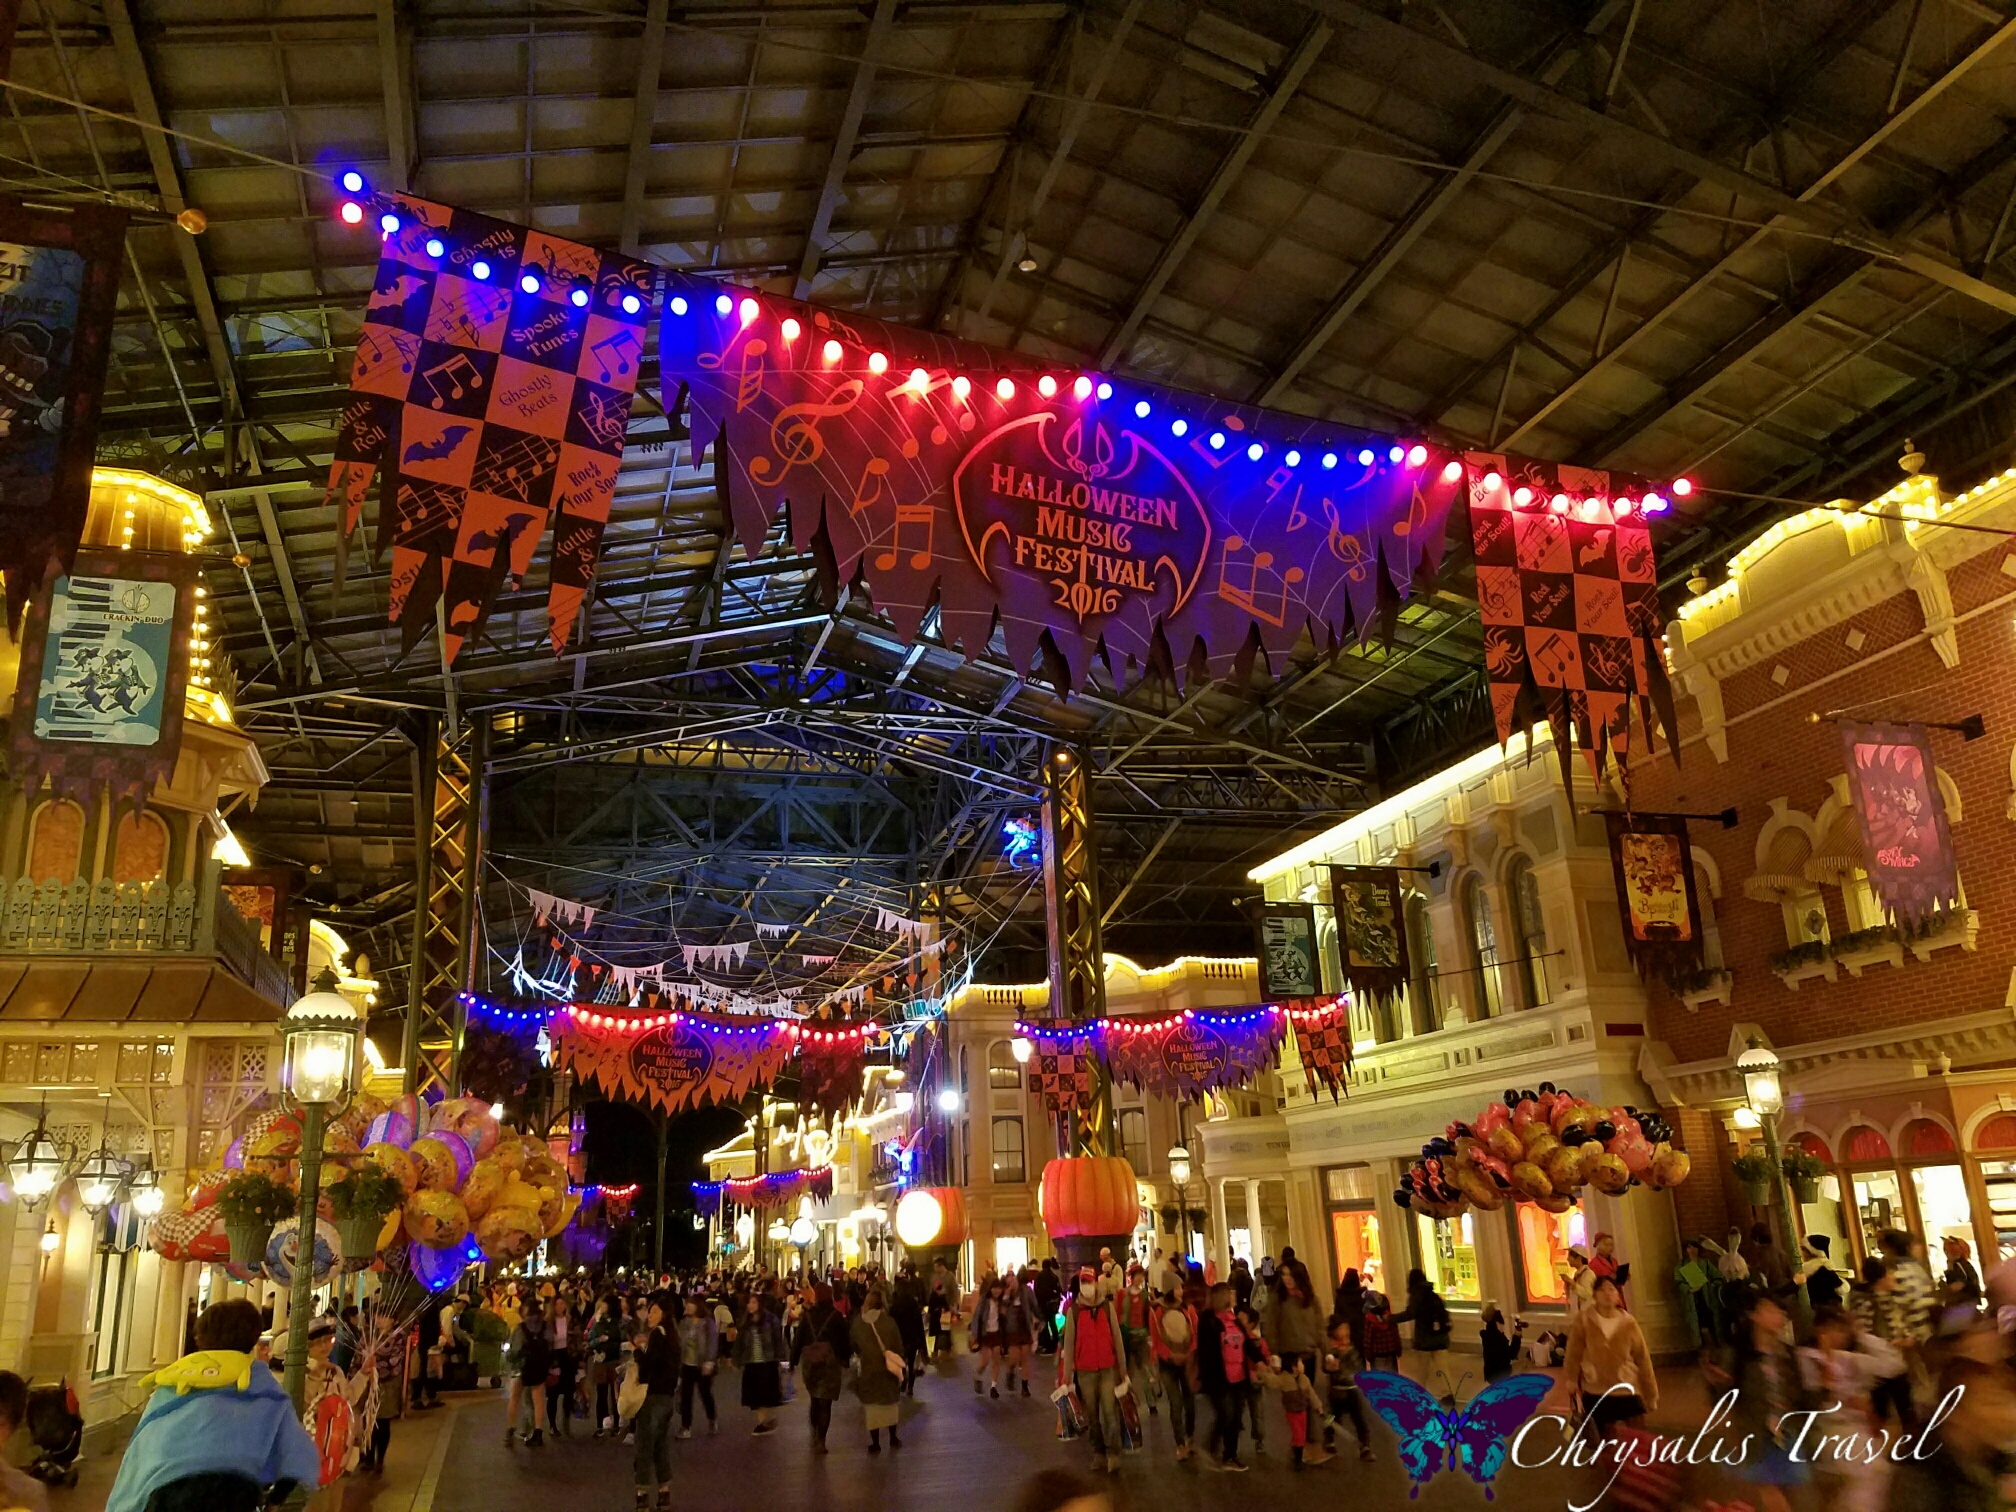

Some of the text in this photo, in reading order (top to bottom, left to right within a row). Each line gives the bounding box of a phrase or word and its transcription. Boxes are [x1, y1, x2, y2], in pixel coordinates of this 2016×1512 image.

[511, 310, 571, 342] Spooky
[526, 329, 579, 357] Tunes
[499, 374, 552, 406] Ghostly
[518, 393, 557, 417] Beats
[352, 425, 387, 453] Roll
[353, 421, 368, 435] &
[568, 461, 601, 487] Rock
[563, 487, 595, 510] Your
[990, 462, 1179, 532] HALLOWEEN
[1036, 505, 1133, 552] MUSIC
[578, 547, 595, 562] &
[1015, 535, 1155, 592] FESTIVAL
[1049, 579, 1123, 618] 2016
[1530, 582, 1551, 604] Rock
[1584, 588, 1605, 611] Rock
[1531, 603, 1553, 623] Your
[1583, 608, 1603, 628] Your
[642, 1044, 703, 1059] HALLOWEEN
[656, 1056, 687, 1068] MUSIC
[648, 1066, 693, 1080] FESTIVAL
[659, 1079, 682, 1090] 2016
